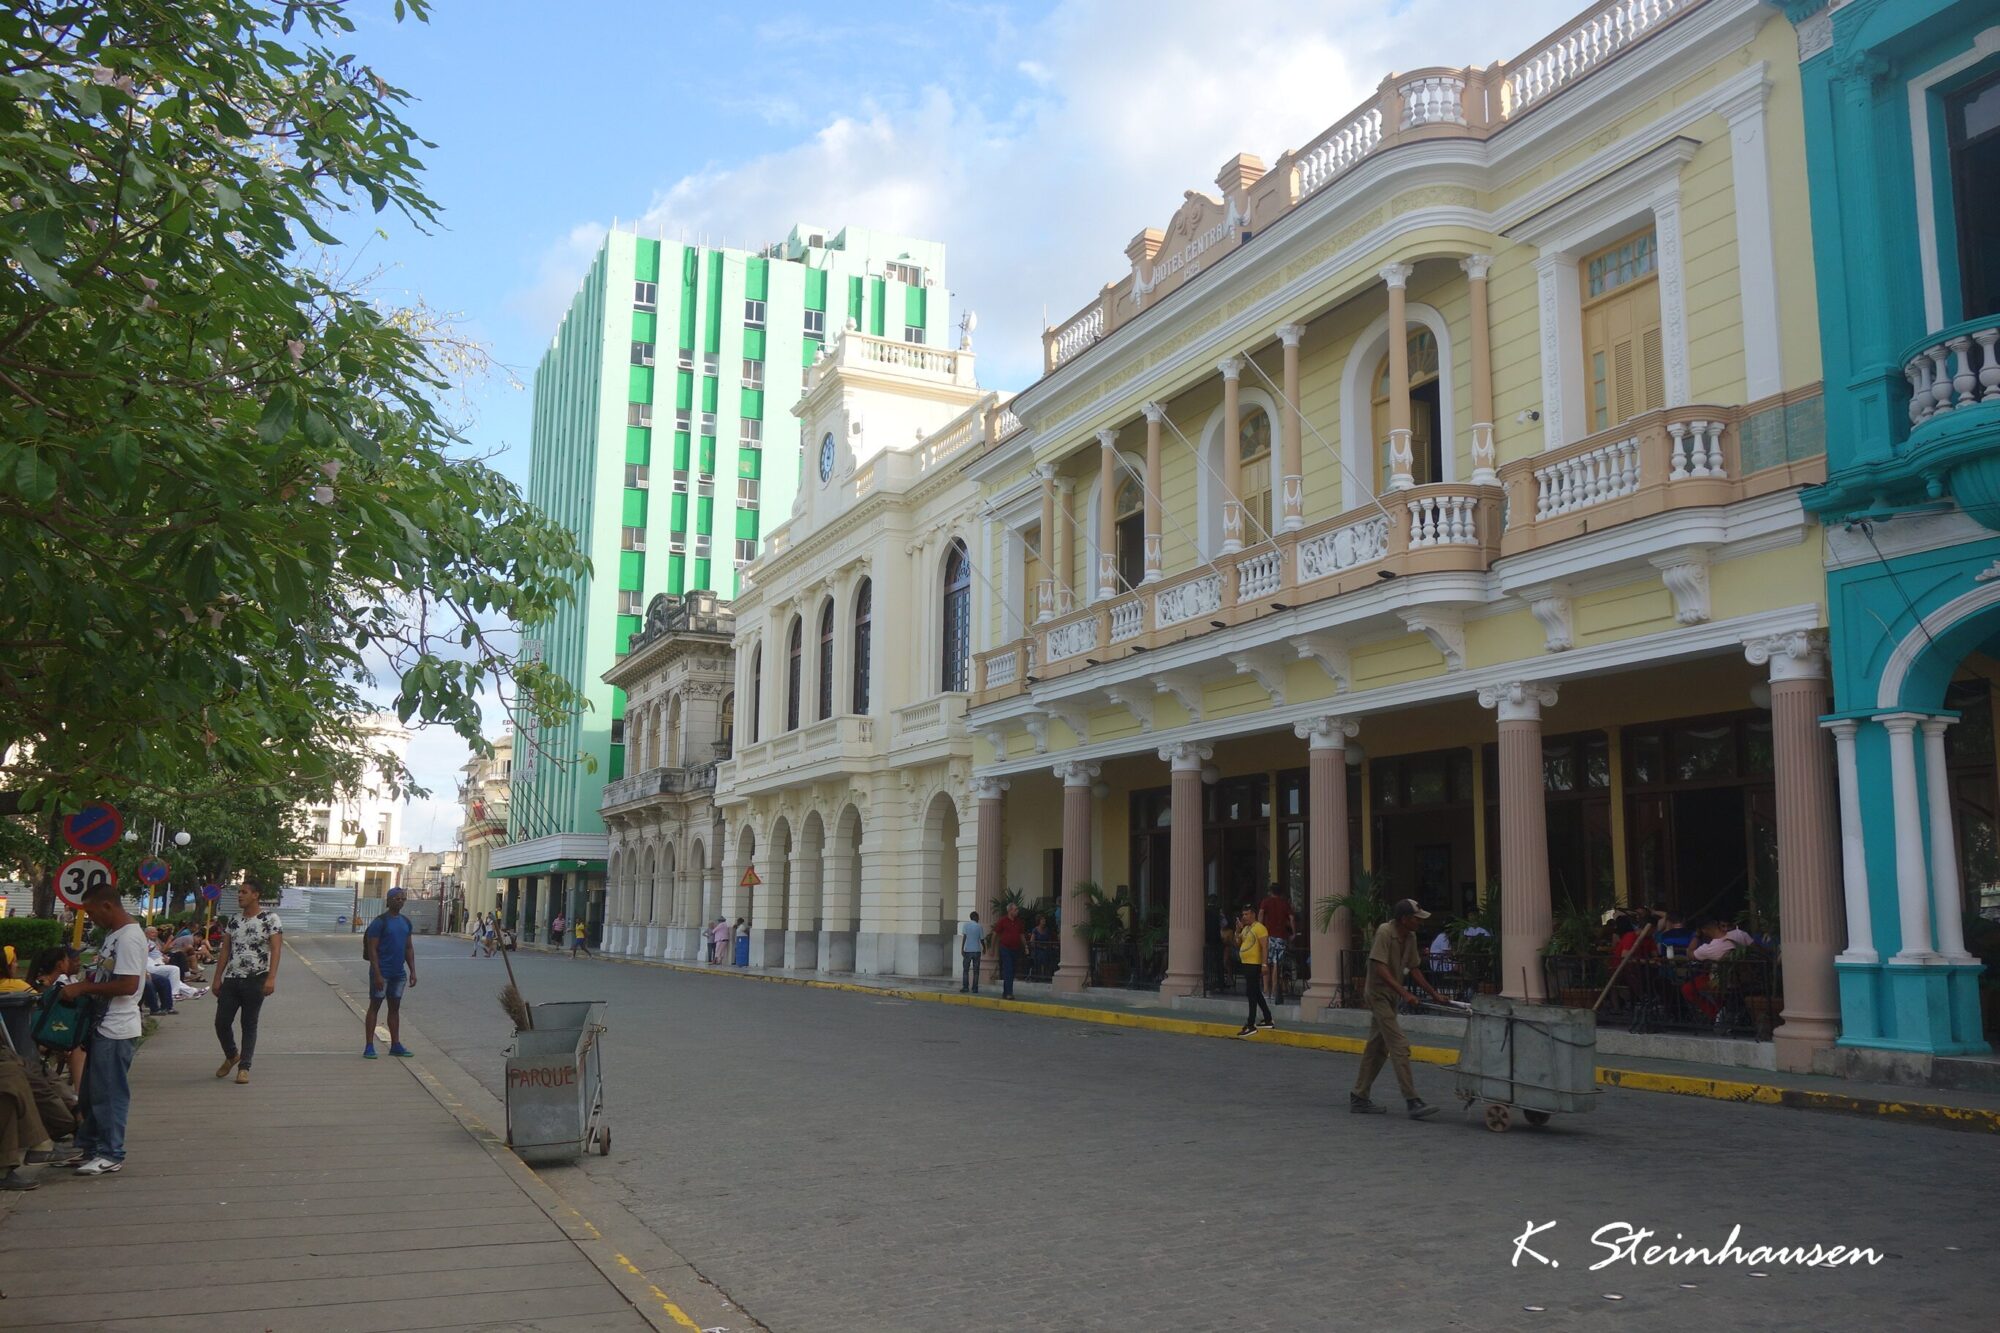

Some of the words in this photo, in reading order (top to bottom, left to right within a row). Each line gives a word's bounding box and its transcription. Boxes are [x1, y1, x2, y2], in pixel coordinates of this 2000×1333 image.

[1155, 251, 1184, 284] HOTEL
[64, 867, 107, 895] 30
[509, 1065, 575, 1088] PARQUE
